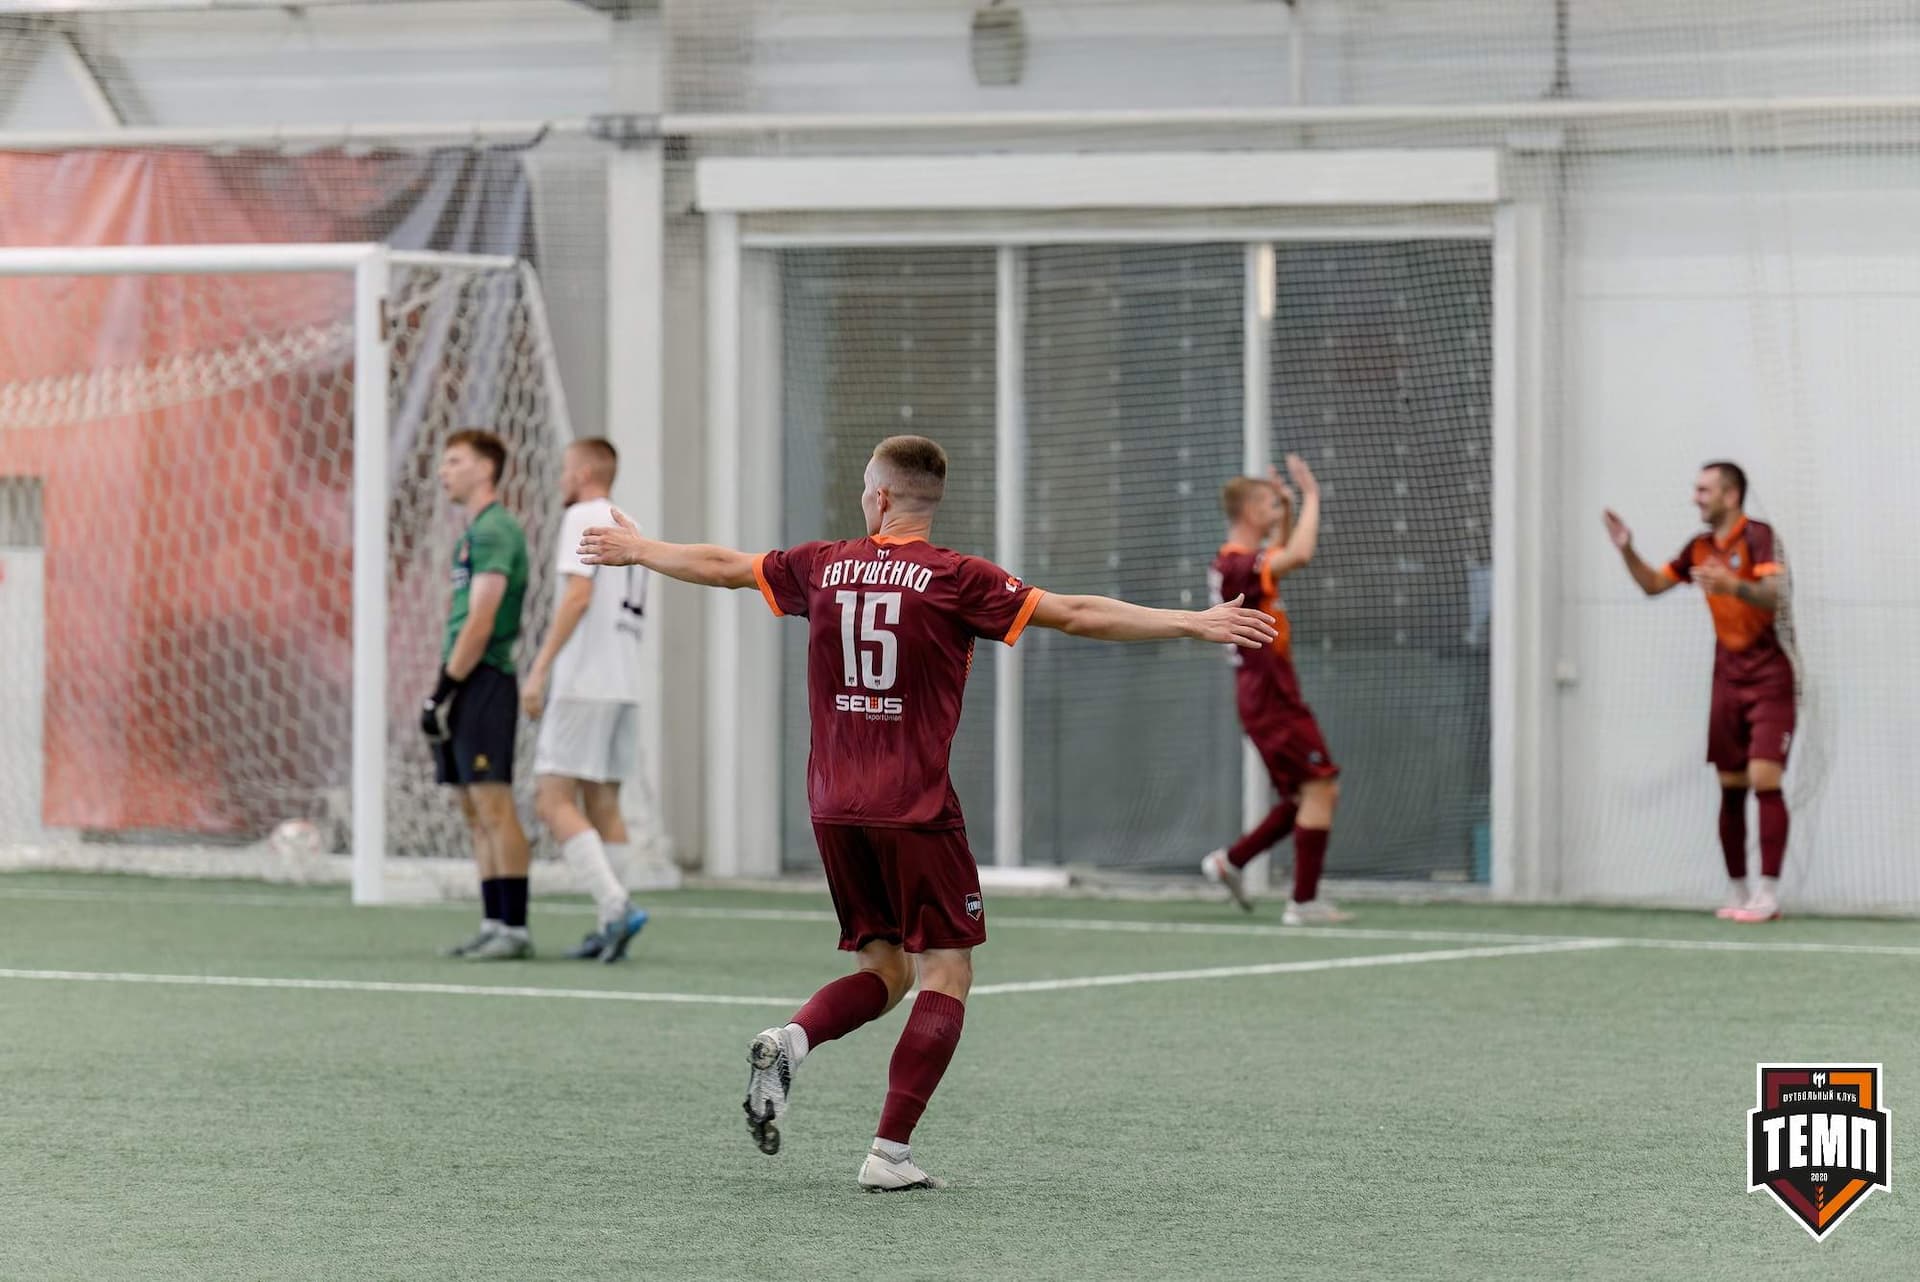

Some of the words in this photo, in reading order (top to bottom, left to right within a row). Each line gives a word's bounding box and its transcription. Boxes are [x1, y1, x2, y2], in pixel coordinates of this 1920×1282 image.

[821, 559, 933, 593] ЕВТУШЕНКО
[835, 590, 902, 691] 15
[835, 694, 903, 714] SEUS
